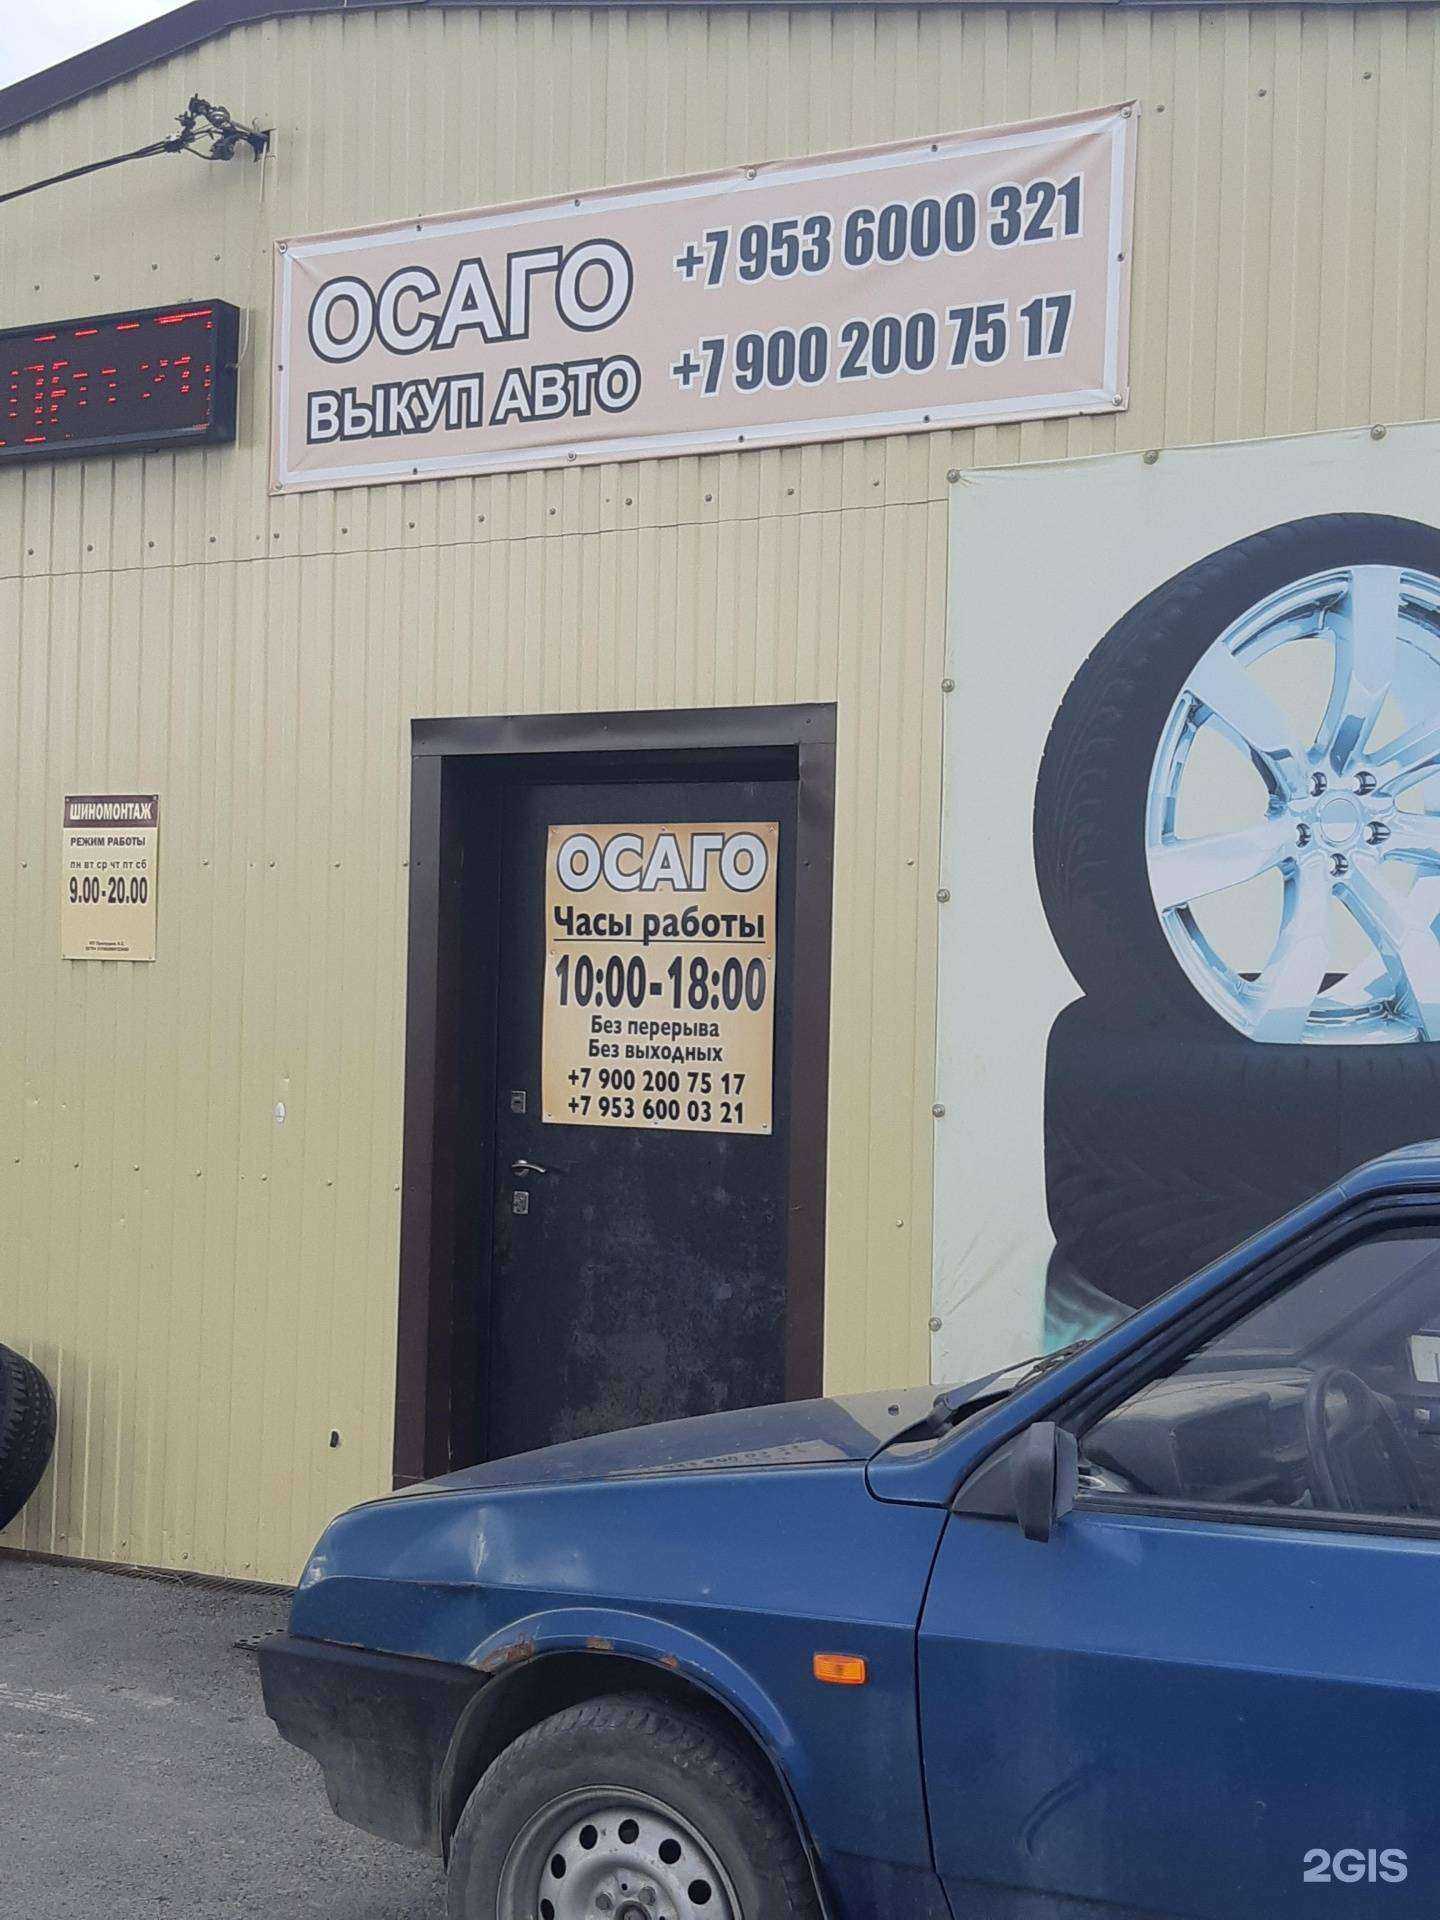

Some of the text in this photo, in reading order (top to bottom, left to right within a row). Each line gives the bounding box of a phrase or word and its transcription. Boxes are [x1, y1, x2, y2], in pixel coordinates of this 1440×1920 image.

[674, 175, 1082, 287] +7 953 6000 321
[308, 238, 633, 364] ОСАГО
[671, 294, 1073, 395] +7 900 200 75 17
[306, 354, 641, 445] ВЫКУП АВТО
[70, 803, 152, 820] ШИНОМОНТАЖ
[70, 836, 146, 847] РЕЖИМ РАБОТЫ
[70, 859, 147, 872] пн вт ср чт пт сб
[556, 832, 769, 892] ОСАГО
[553, 905, 764, 946] Часы работы
[555, 954, 767, 1011] 10:00-18:00
[591, 1015, 720, 1041] Без перерыва
[588, 1038, 723, 1064] Без выходных
[568, 1068, 746, 1095] +7 900 200 75 17
[568, 1096, 744, 1124] +7 953 600 03 21
